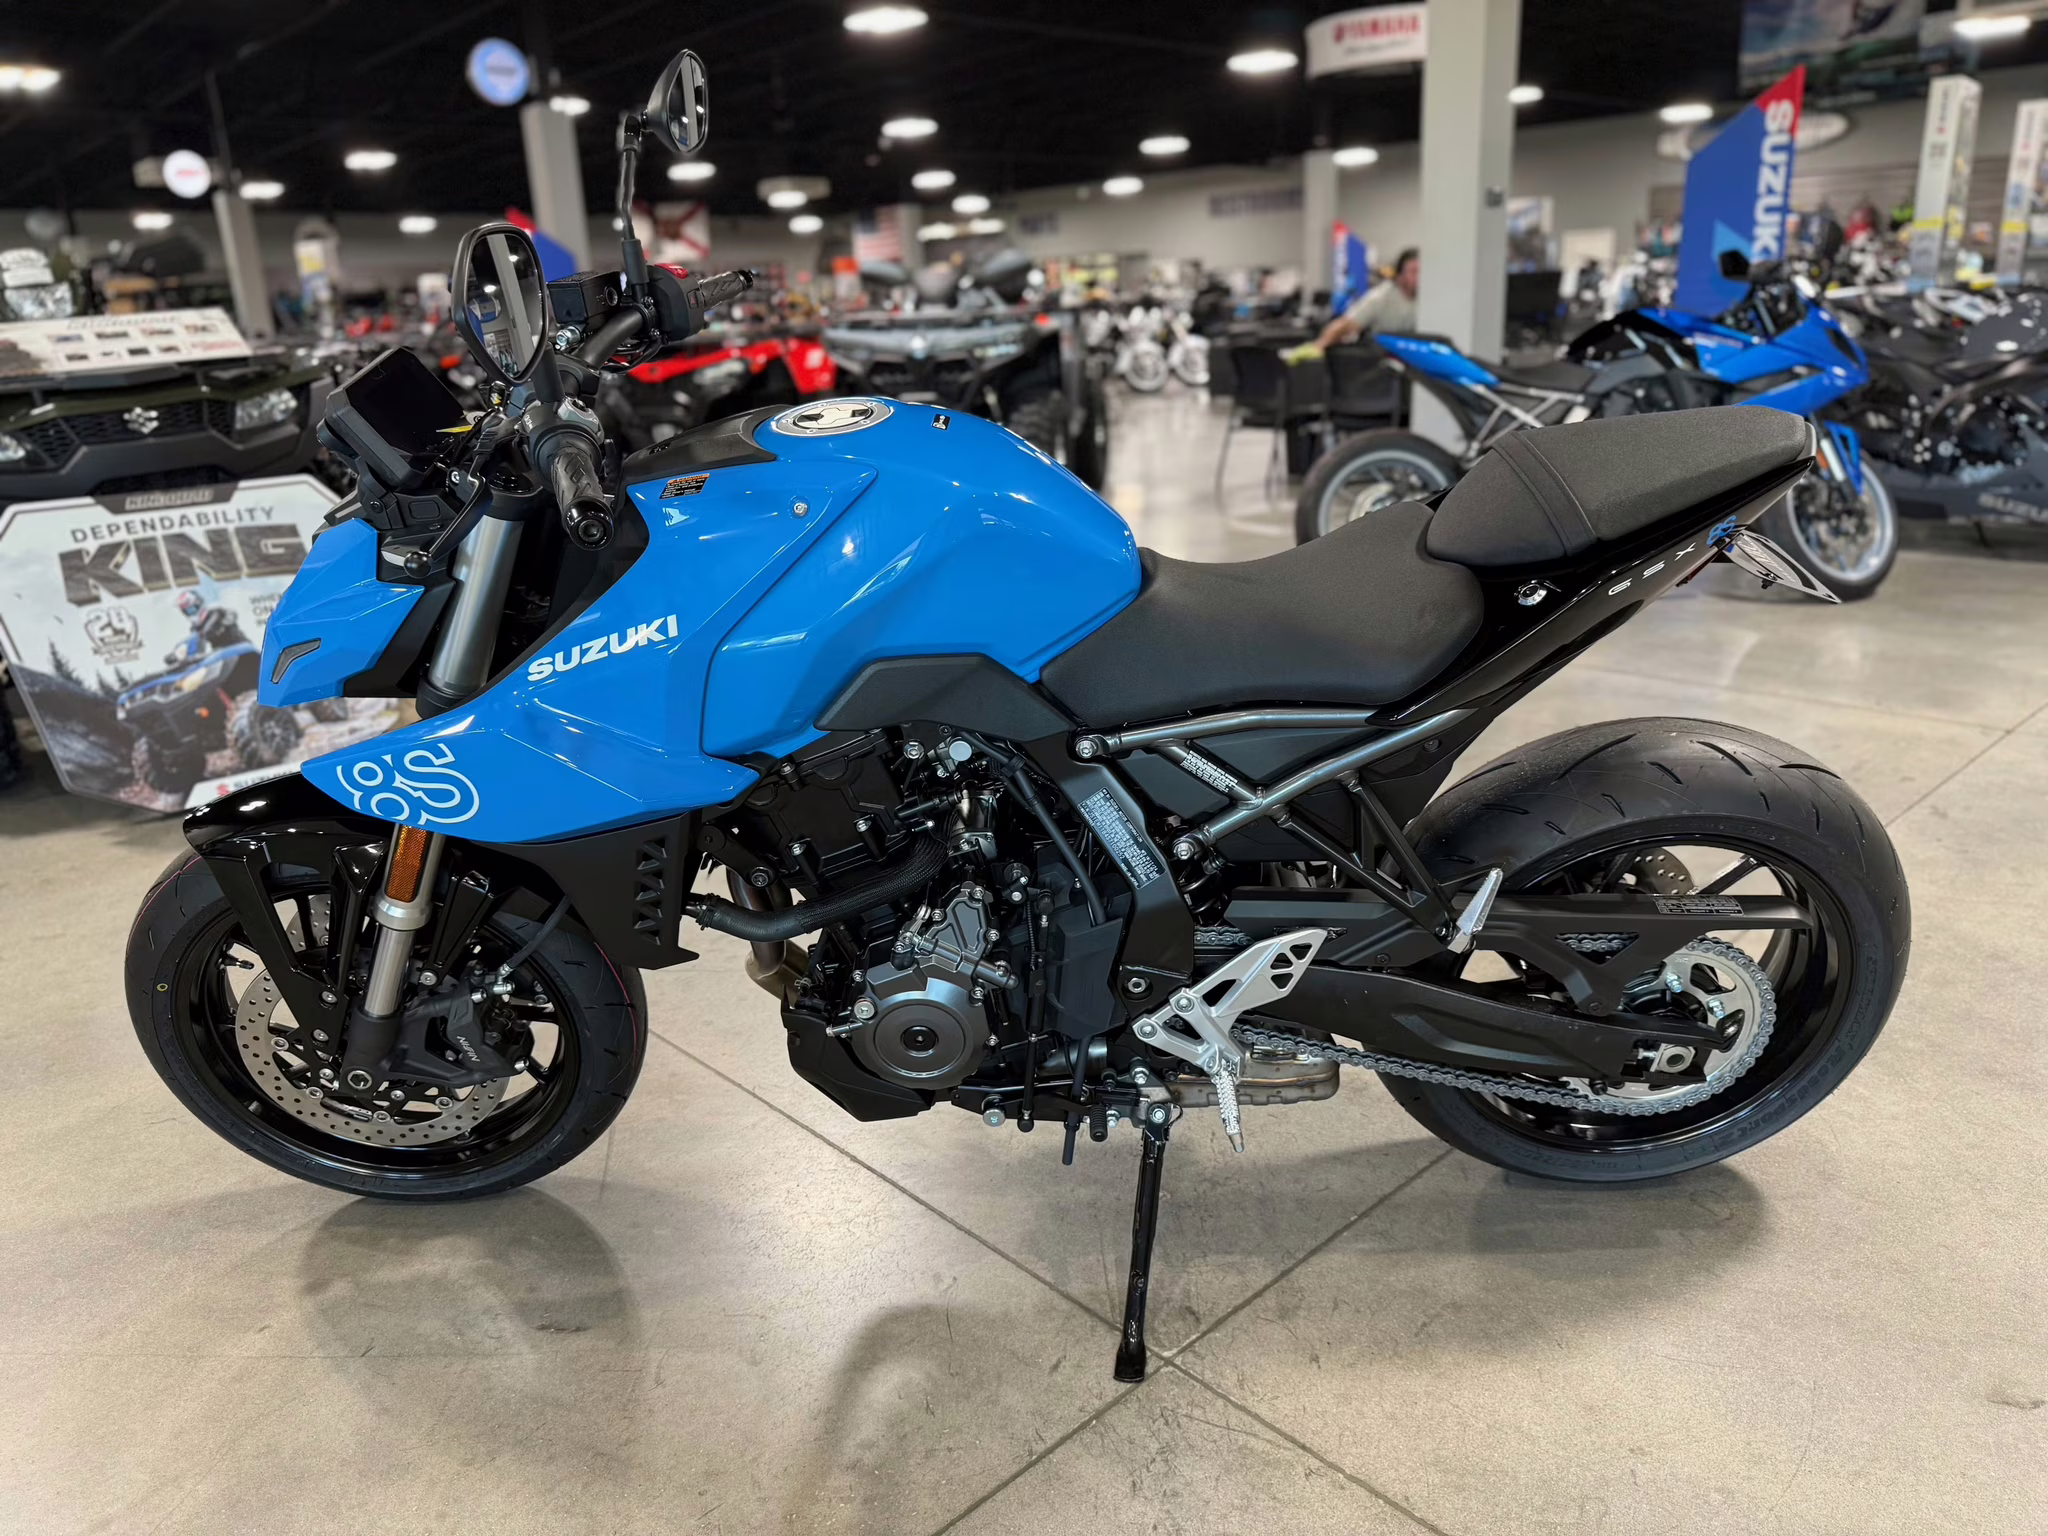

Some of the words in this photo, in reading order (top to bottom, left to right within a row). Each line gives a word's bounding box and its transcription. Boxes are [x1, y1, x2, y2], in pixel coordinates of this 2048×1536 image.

[1752, 99, 1796, 265] SUZUK
[71, 506, 275, 544] DEPENDABILITY
[58, 523, 309, 607] KING
[527, 614, 679, 682] SUZUKI
